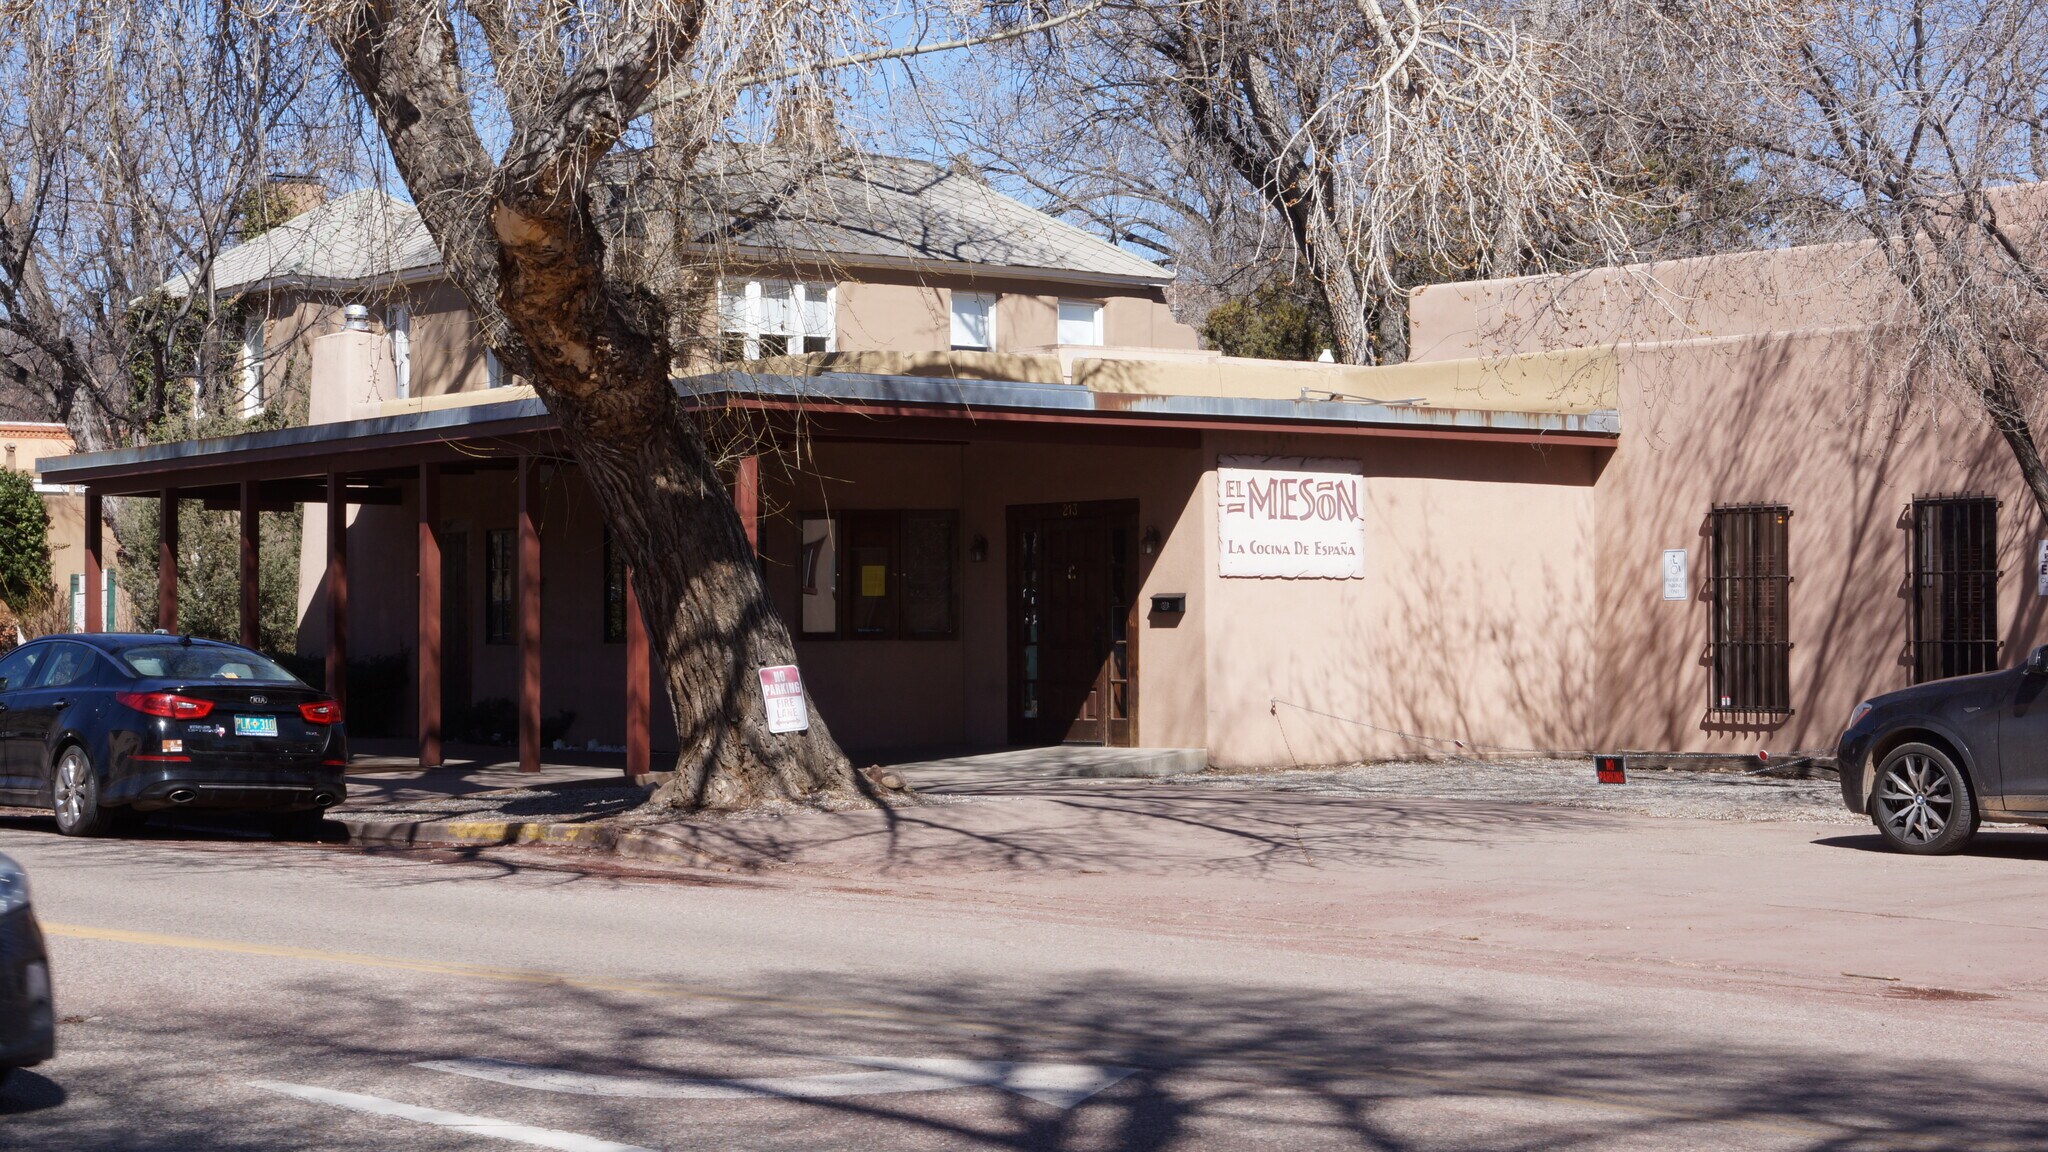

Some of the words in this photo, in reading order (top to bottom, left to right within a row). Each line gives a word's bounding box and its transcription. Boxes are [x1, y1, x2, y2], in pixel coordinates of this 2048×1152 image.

[1226, 480, 1245, 498] EL
[1247, 477, 1359, 522] MESON
[1063, 503, 1078, 516] 213
[773, 670, 786, 682] NO
[764, 681, 801, 696] PARKING
[776, 697, 795, 708] FIRE
[777, 708, 799, 719] LANE
[1605, 759, 1614, 770] NO
[1598, 771, 1624, 783] PARKING
